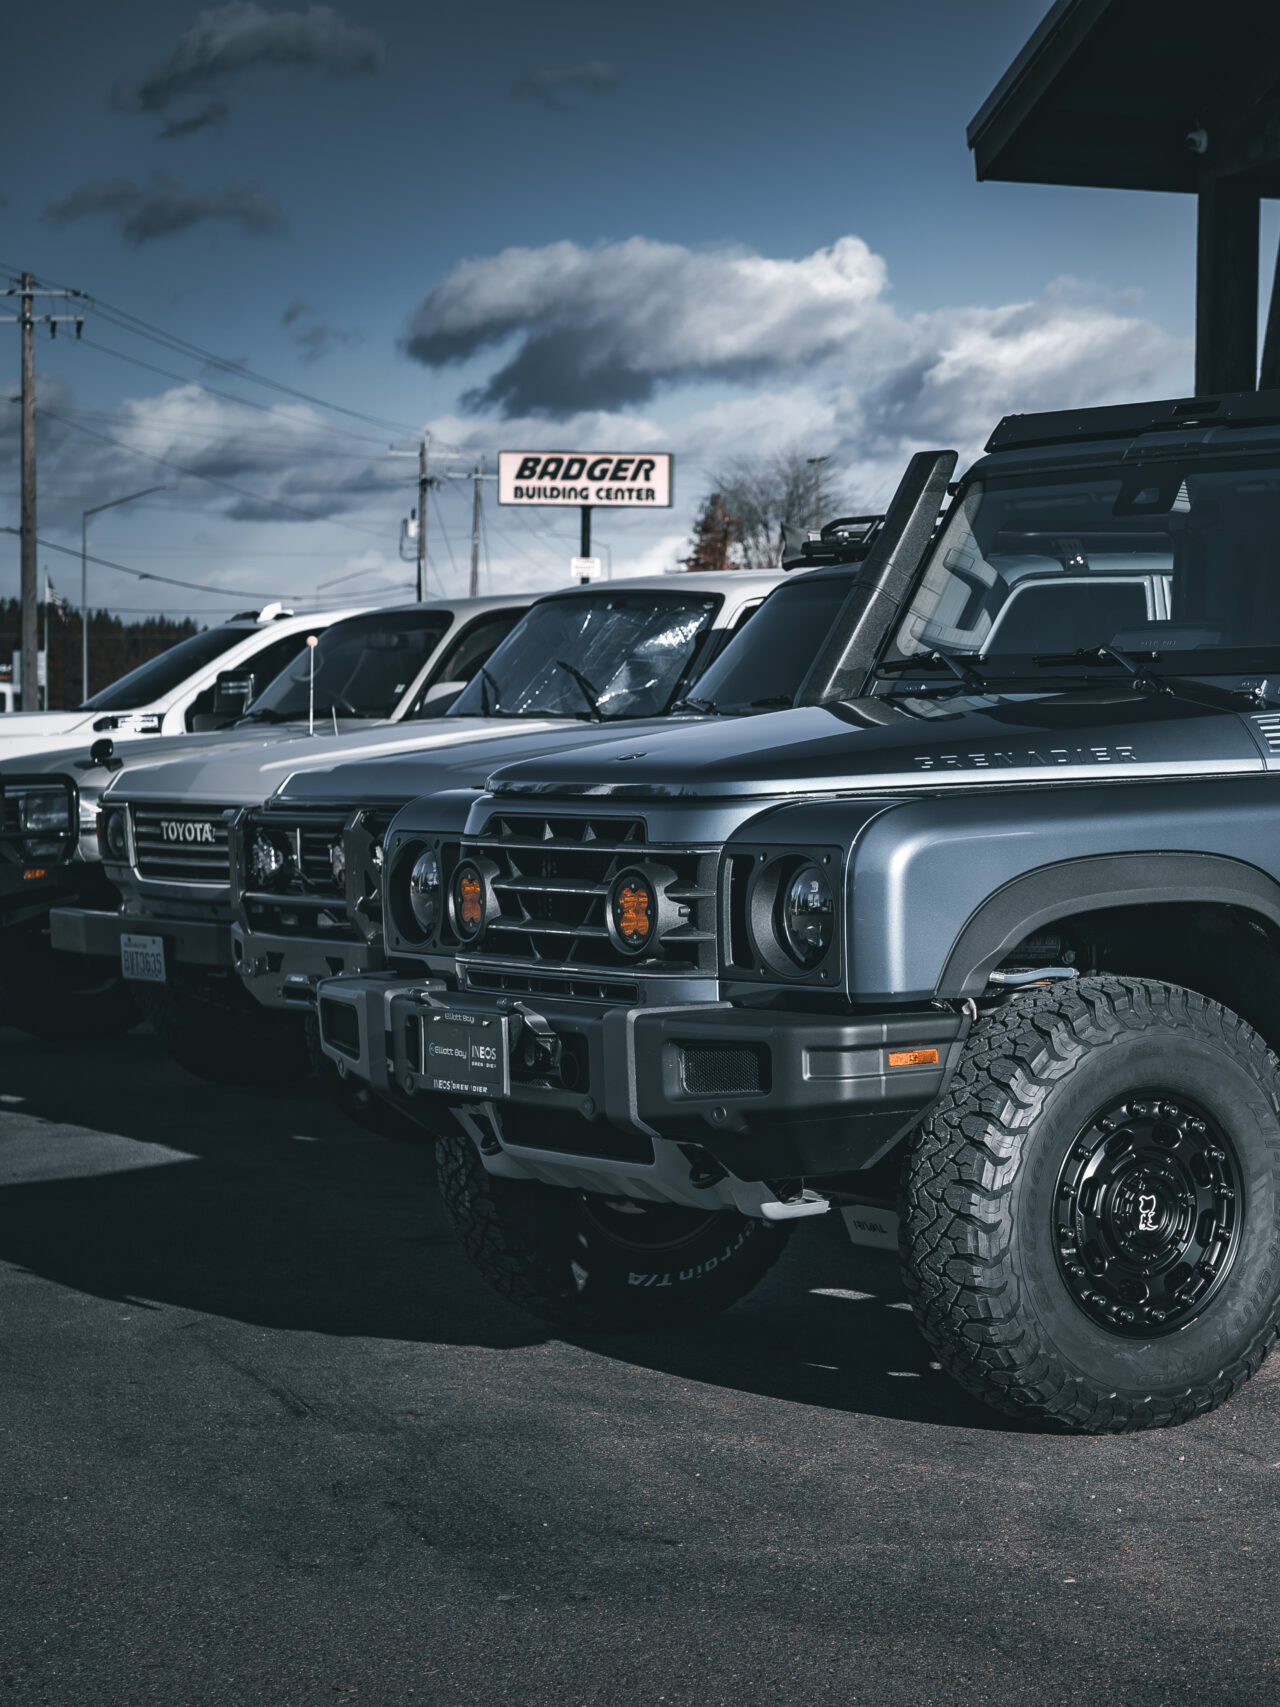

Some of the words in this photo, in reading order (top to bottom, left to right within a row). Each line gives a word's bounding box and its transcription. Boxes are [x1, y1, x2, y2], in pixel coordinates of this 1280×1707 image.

[515, 457, 655, 481] BADGER
[514, 486, 589, 500] BUILDING
[596, 487, 655, 501] CENTER
[914, 746, 1137, 769] GRENADIER
[160, 821, 213, 843] TOYOTA
[444, 1012, 462, 1021] Elliott
[462, 1014, 475, 1024] Bay
[434, 1045, 454, 1056] Elliott
[454, 1048, 467, 1060] Bay
[471, 1045, 497, 1060] INEOS
[433, 1079, 451, 1090] INEOS
[853, 1220, 889, 1234] RIVAL
